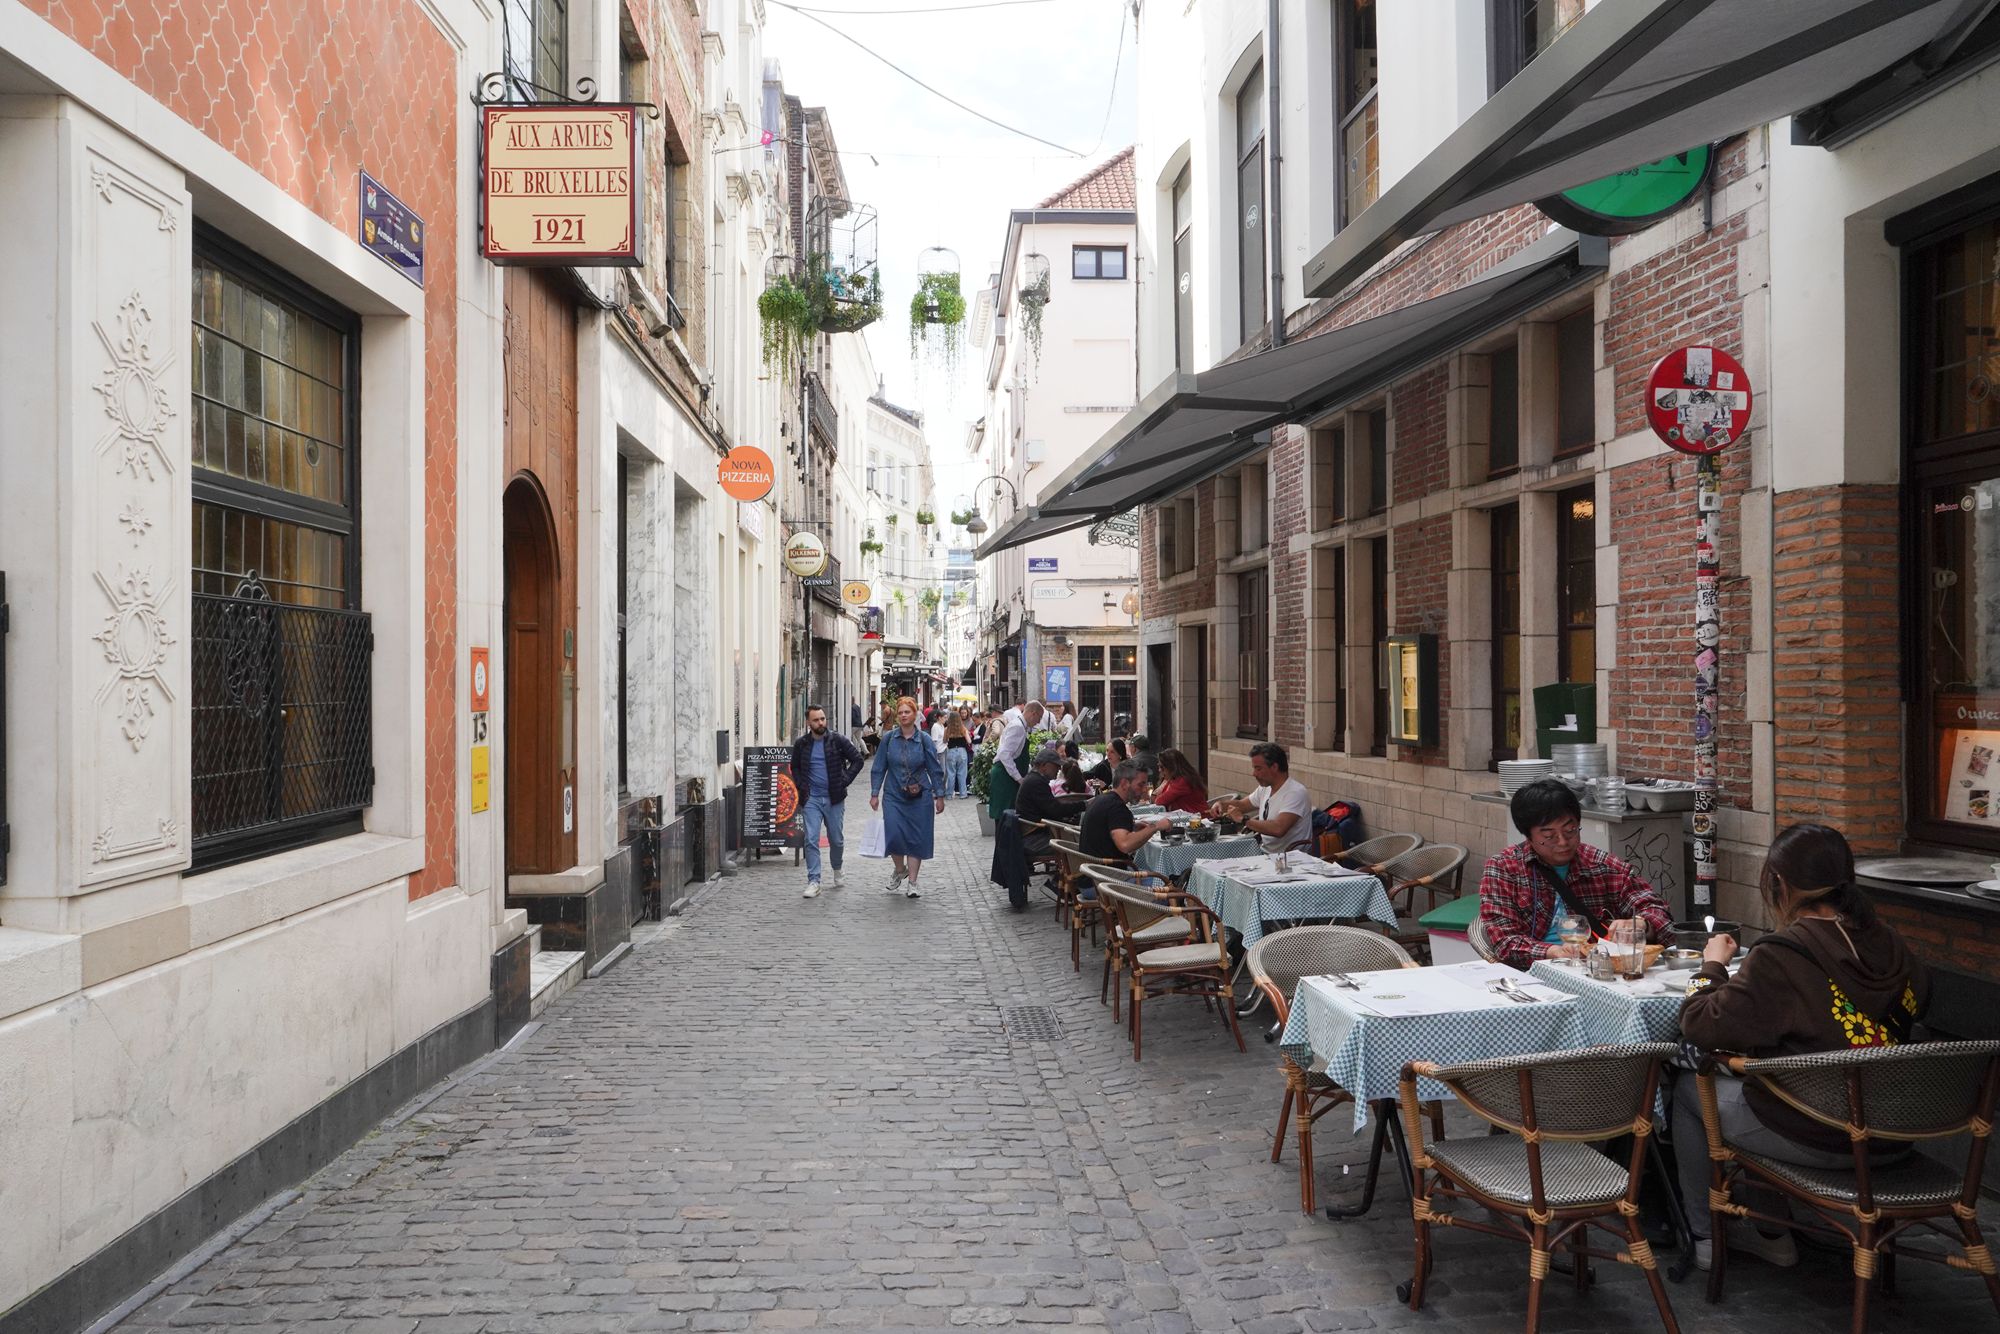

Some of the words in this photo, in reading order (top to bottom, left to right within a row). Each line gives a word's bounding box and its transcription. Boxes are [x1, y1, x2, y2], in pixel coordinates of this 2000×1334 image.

[507, 124, 541, 148] AUX
[550, 123, 613, 147] ARMES
[490, 170, 514, 194] DE
[524, 169, 628, 194] BRUXELLES
[534, 218, 585, 241] 1921
[377, 226, 393, 246] Armes
[393, 239, 400, 250] de
[399, 242, 420, 266] Bruxelles
[721, 471, 771, 483] PIZZERIA
[731, 460, 762, 471] NOVA
[472, 712, 488, 743] 13
